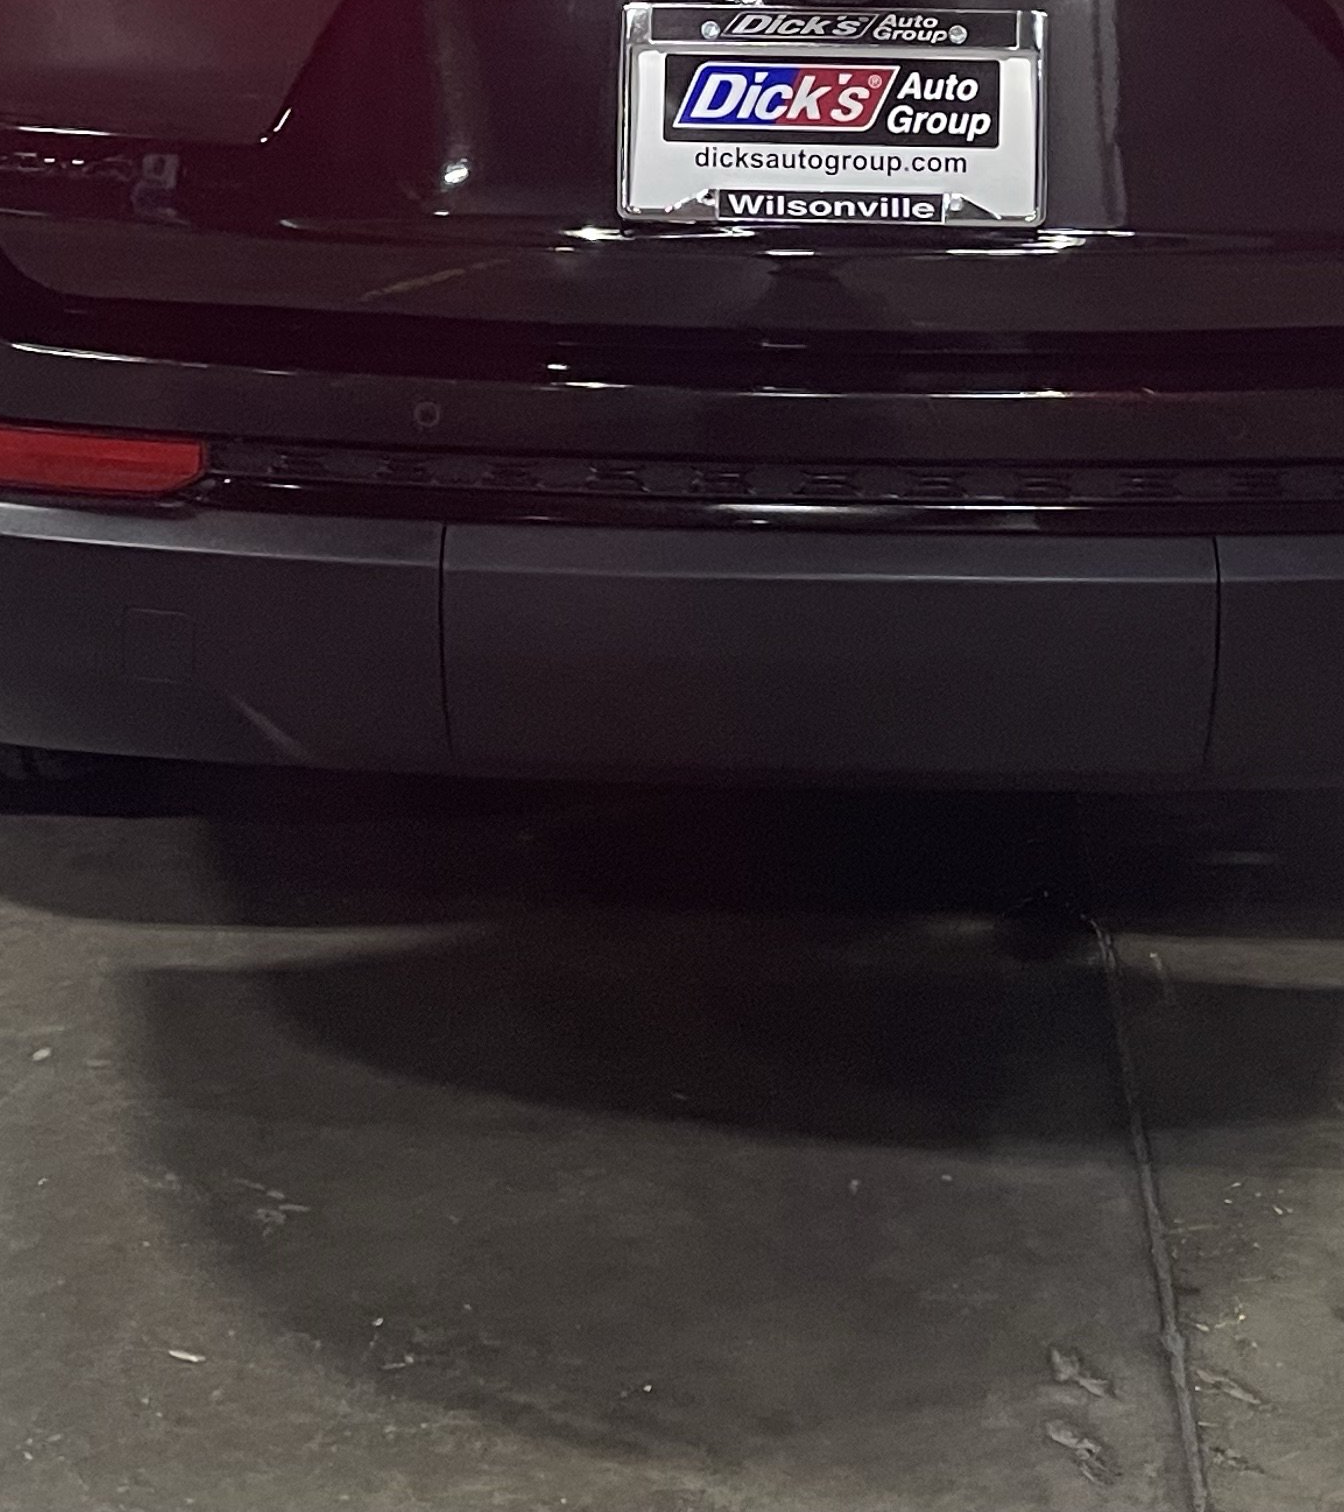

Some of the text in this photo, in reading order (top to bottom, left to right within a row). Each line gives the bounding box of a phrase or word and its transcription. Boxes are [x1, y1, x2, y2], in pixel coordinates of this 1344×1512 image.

[731, 13, 862, 37] Dick's
[872, 26, 949, 44] Group
[876, 13, 939, 29] Auto
[689, 71, 870, 123] Dick's
[896, 71, 979, 102] Auto
[886, 108, 992, 143] Group
[693, 146, 968, 177] dicksautogroup.com
[727, 193, 935, 220] Wilsonville
